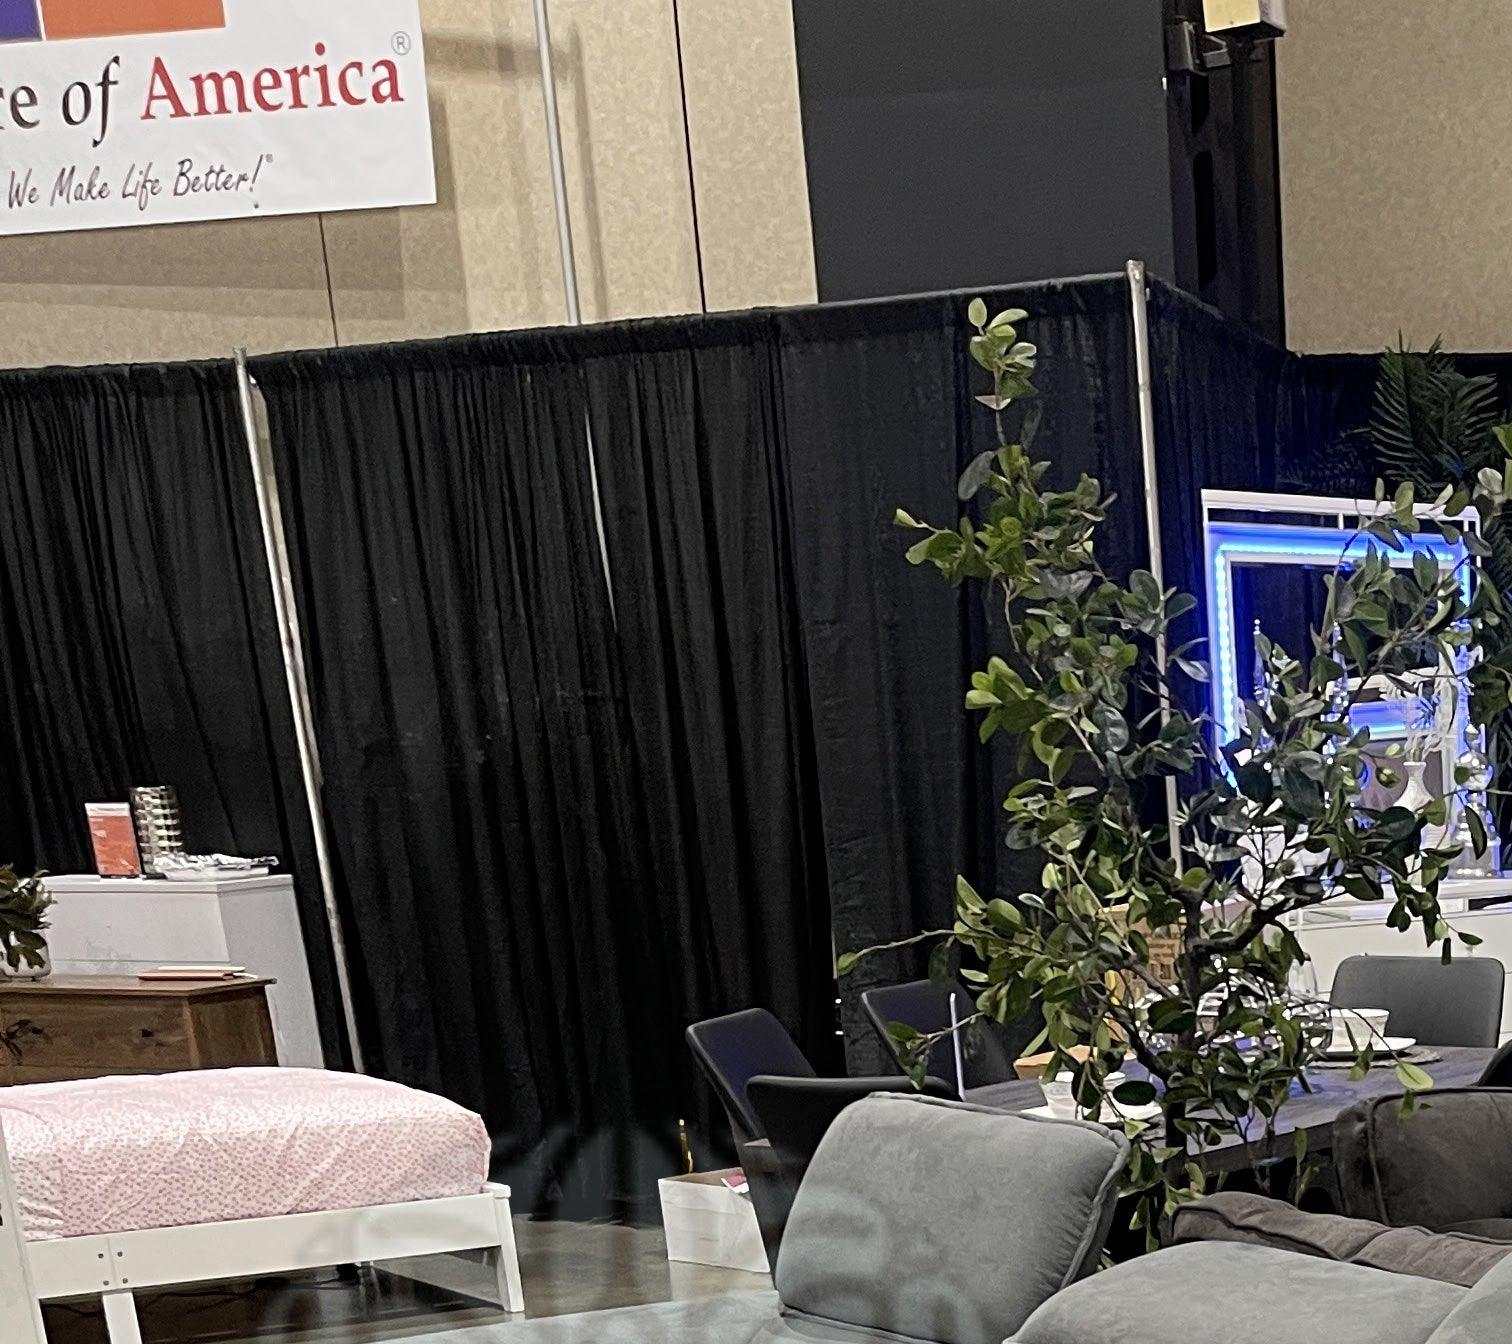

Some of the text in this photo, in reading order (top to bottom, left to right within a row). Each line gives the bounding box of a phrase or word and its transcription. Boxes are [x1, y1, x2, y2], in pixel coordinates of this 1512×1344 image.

[0, 86, 41, 130] e
[62, 56, 120, 148] of
[8, 167, 40, 210] We
[49, 164, 111, 208] Make
[121, 160, 163, 212] Life
